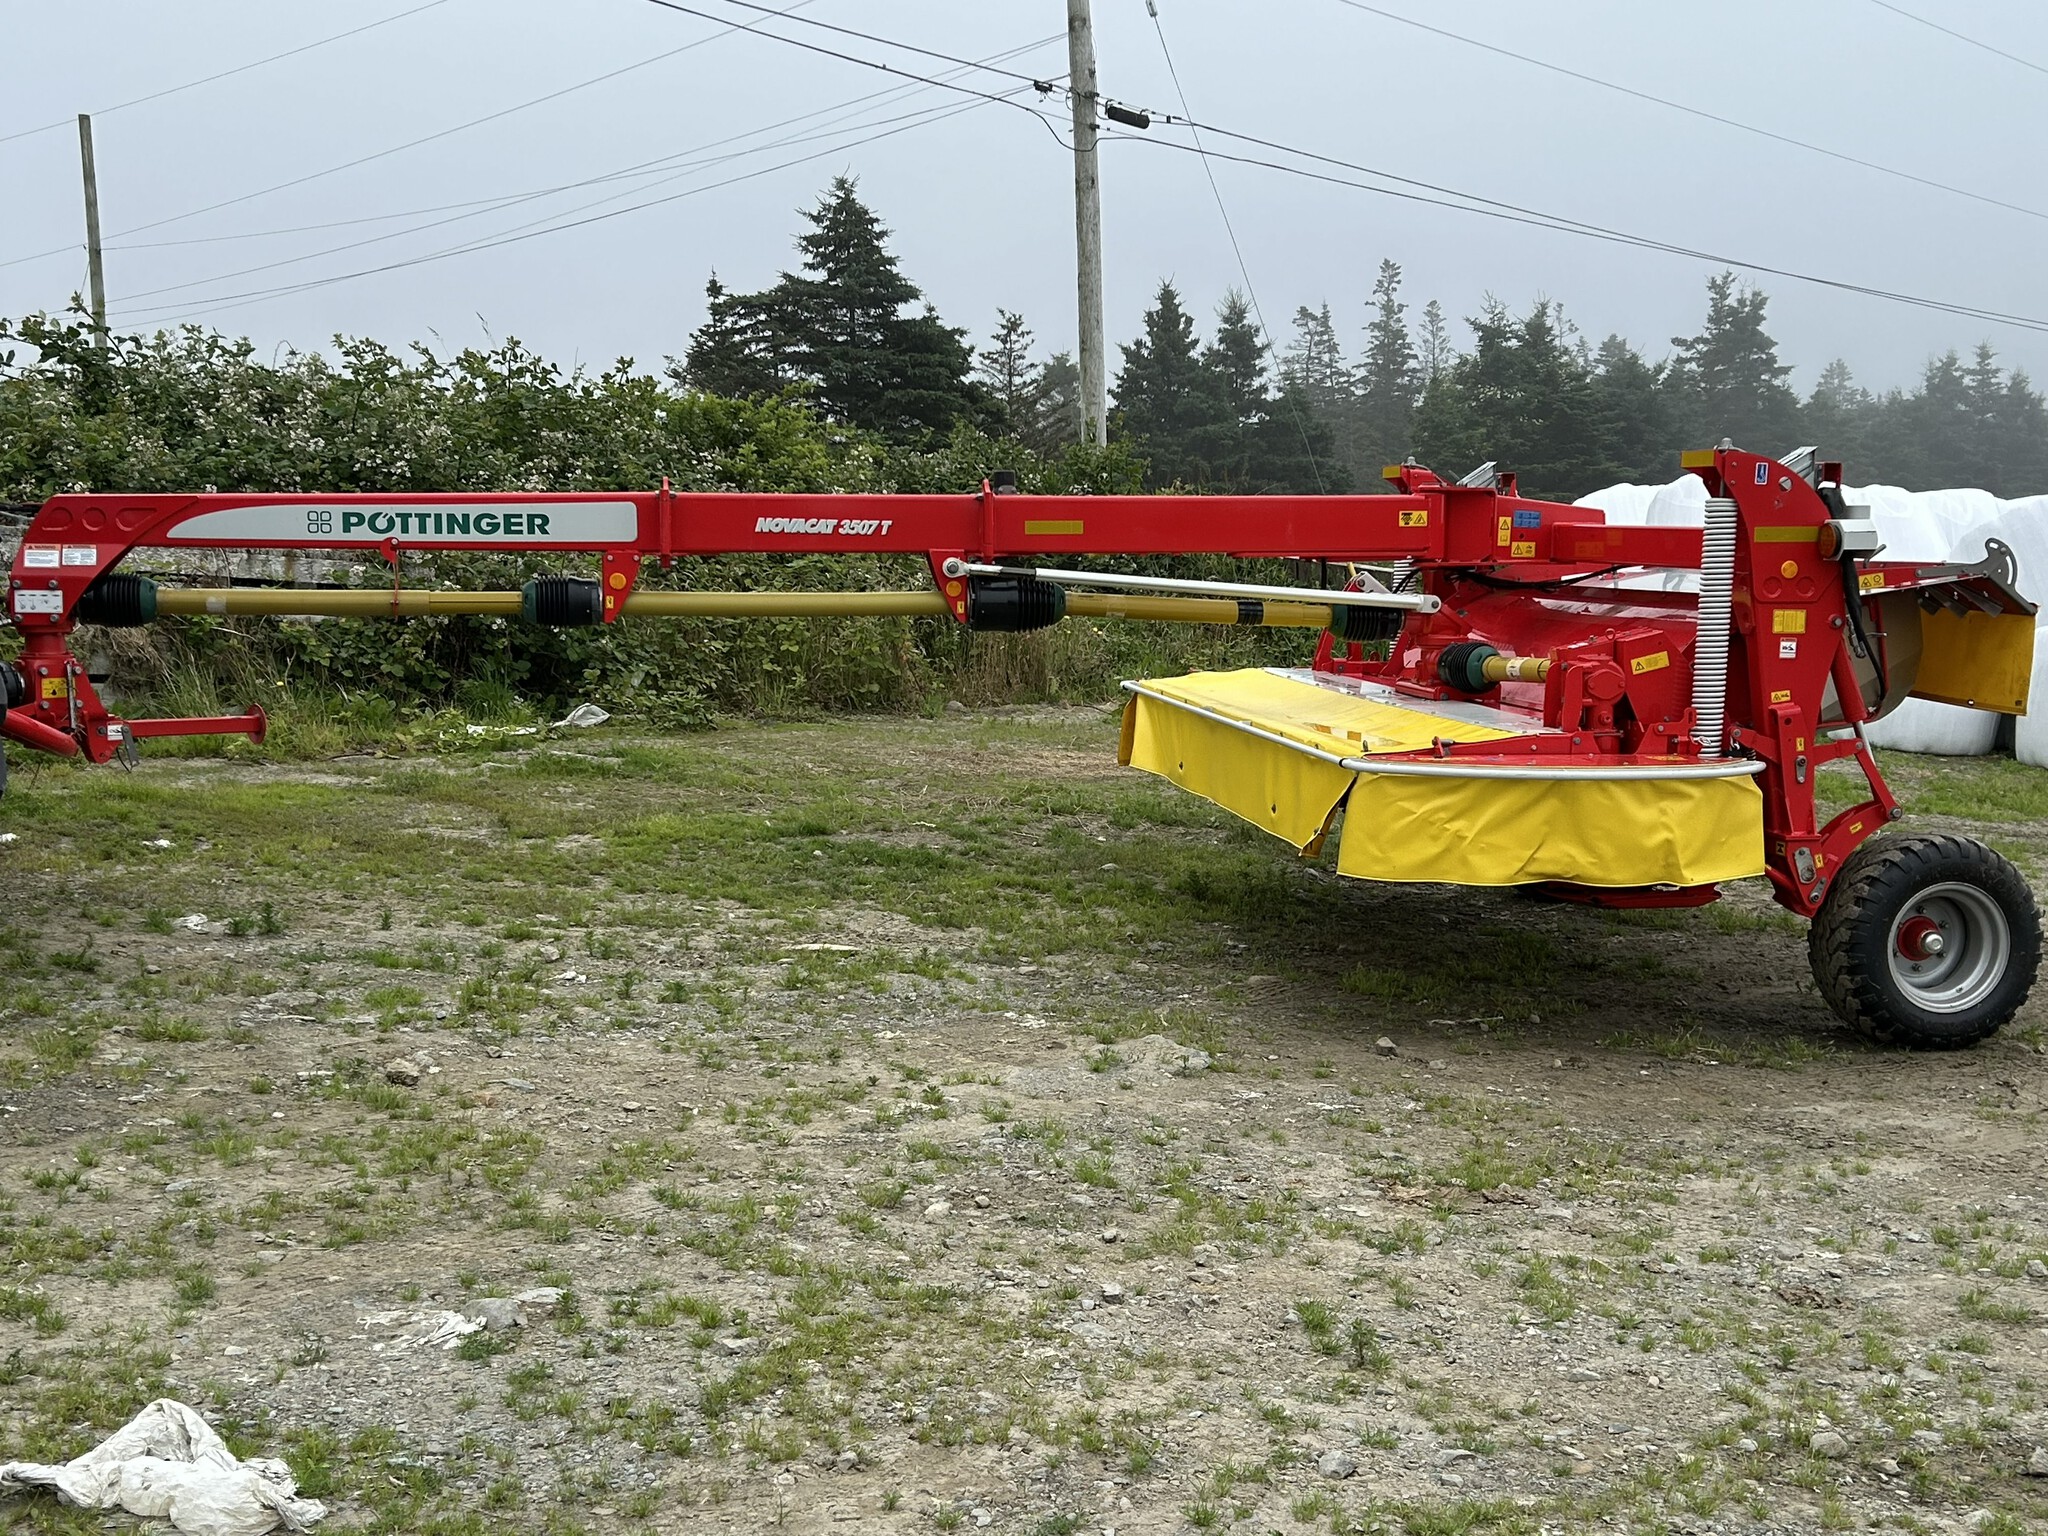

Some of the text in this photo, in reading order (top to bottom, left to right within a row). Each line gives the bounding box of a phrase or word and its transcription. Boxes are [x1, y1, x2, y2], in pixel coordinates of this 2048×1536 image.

[342, 511, 550, 535] PÖTTINGER
[755, 518, 892, 535] NOVACAT 3507 T
